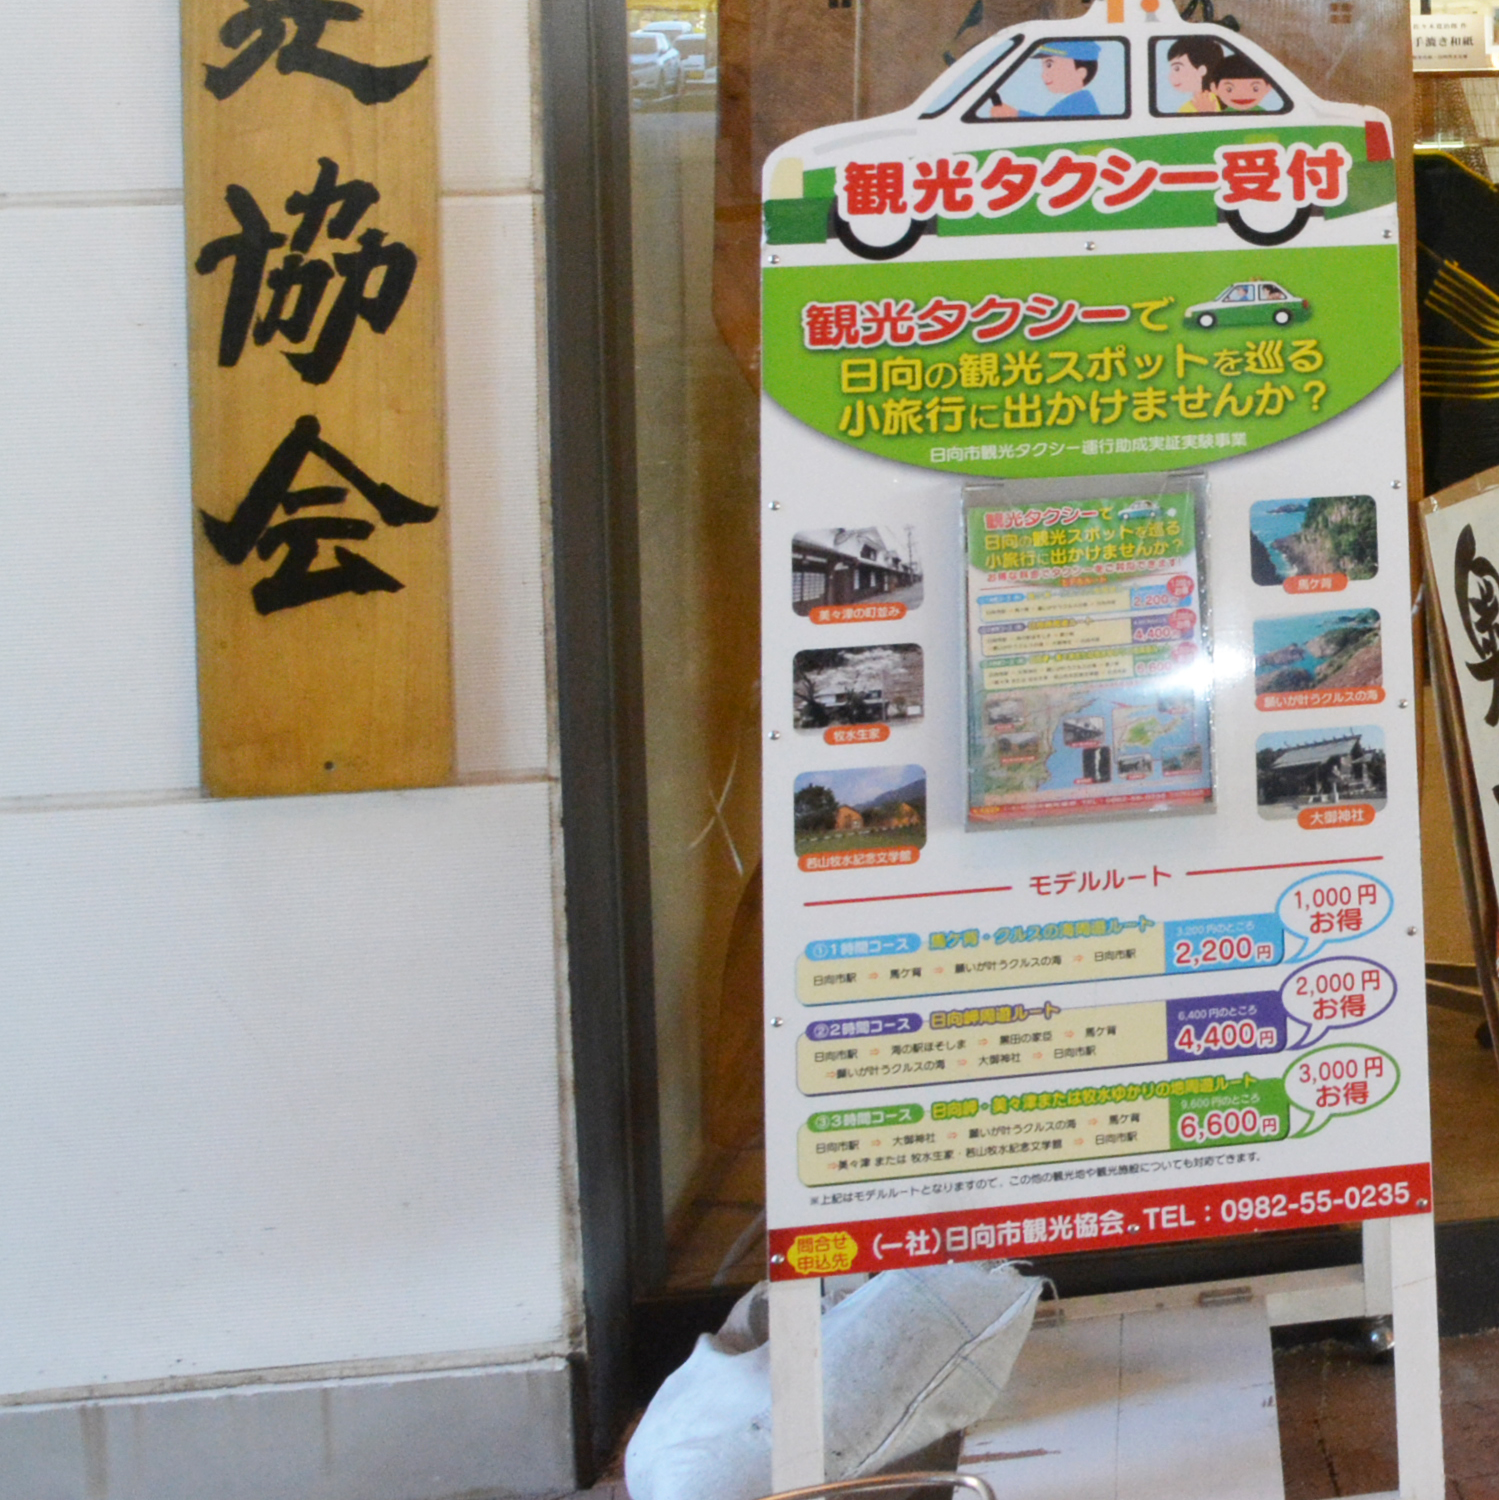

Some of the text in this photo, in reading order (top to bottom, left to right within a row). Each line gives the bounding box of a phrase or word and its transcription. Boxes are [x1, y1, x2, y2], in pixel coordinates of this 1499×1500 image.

[842, 148, 1346, 217] 観光タクシー受付
[804, 295, 1175, 349] 観光タクシーで
[840, 338, 1326, 394] 日向の観光スポットを巡る
[838, 381, 1328, 438] 小旅行に出かけませんか？
[930, 432, 1247, 463] 日向市観光タクシー運行助成実証実験事業
[985, 506, 1113, 530] 観光タクシーで
[818, 606, 901, 621] 美々津の町並み
[833, 727, 881, 742] 牧水生家
[1309, 807, 1365, 825] 大御神社
[1029, 864, 1172, 896] モデルルート
[1294, 884, 1377, 911] 1,000円
[1309, 908, 1363, 934] お得
[1174, 936, 1272, 966] 2,200円
[813, 971, 857, 986] 日向市駅
[1094, 948, 1137, 963] 日向市駅
[1295, 969, 1381, 997] 2,000円
[1312, 994, 1367, 1021] お得
[1177, 1021, 1276, 1053] 4,400円
[814, 1047, 858, 1062] 日向市駅
[978, 1051, 1021, 1066] 大御神社
[1053, 1045, 1097, 1060] 日向市駅
[1298, 1056, 1384, 1085] 3,000円
[1315, 1080, 1369, 1108] お得
[1179, 1109, 1278, 1142] 6,600円
[815, 1140, 860, 1154] 日向市駅
[892, 1132, 936, 1147] 大御神社
[874, 1153, 907, 1166] または
[1095, 1130, 1138, 1145] 日向市駅
[872, 1208, 1125, 1261] (一社)日向市観光協会
[1220, 1180, 1411, 1223] 0982-55-0235
[797, 1233, 848, 1254] 問合せ
[797, 1251, 850, 1271] 申込先
